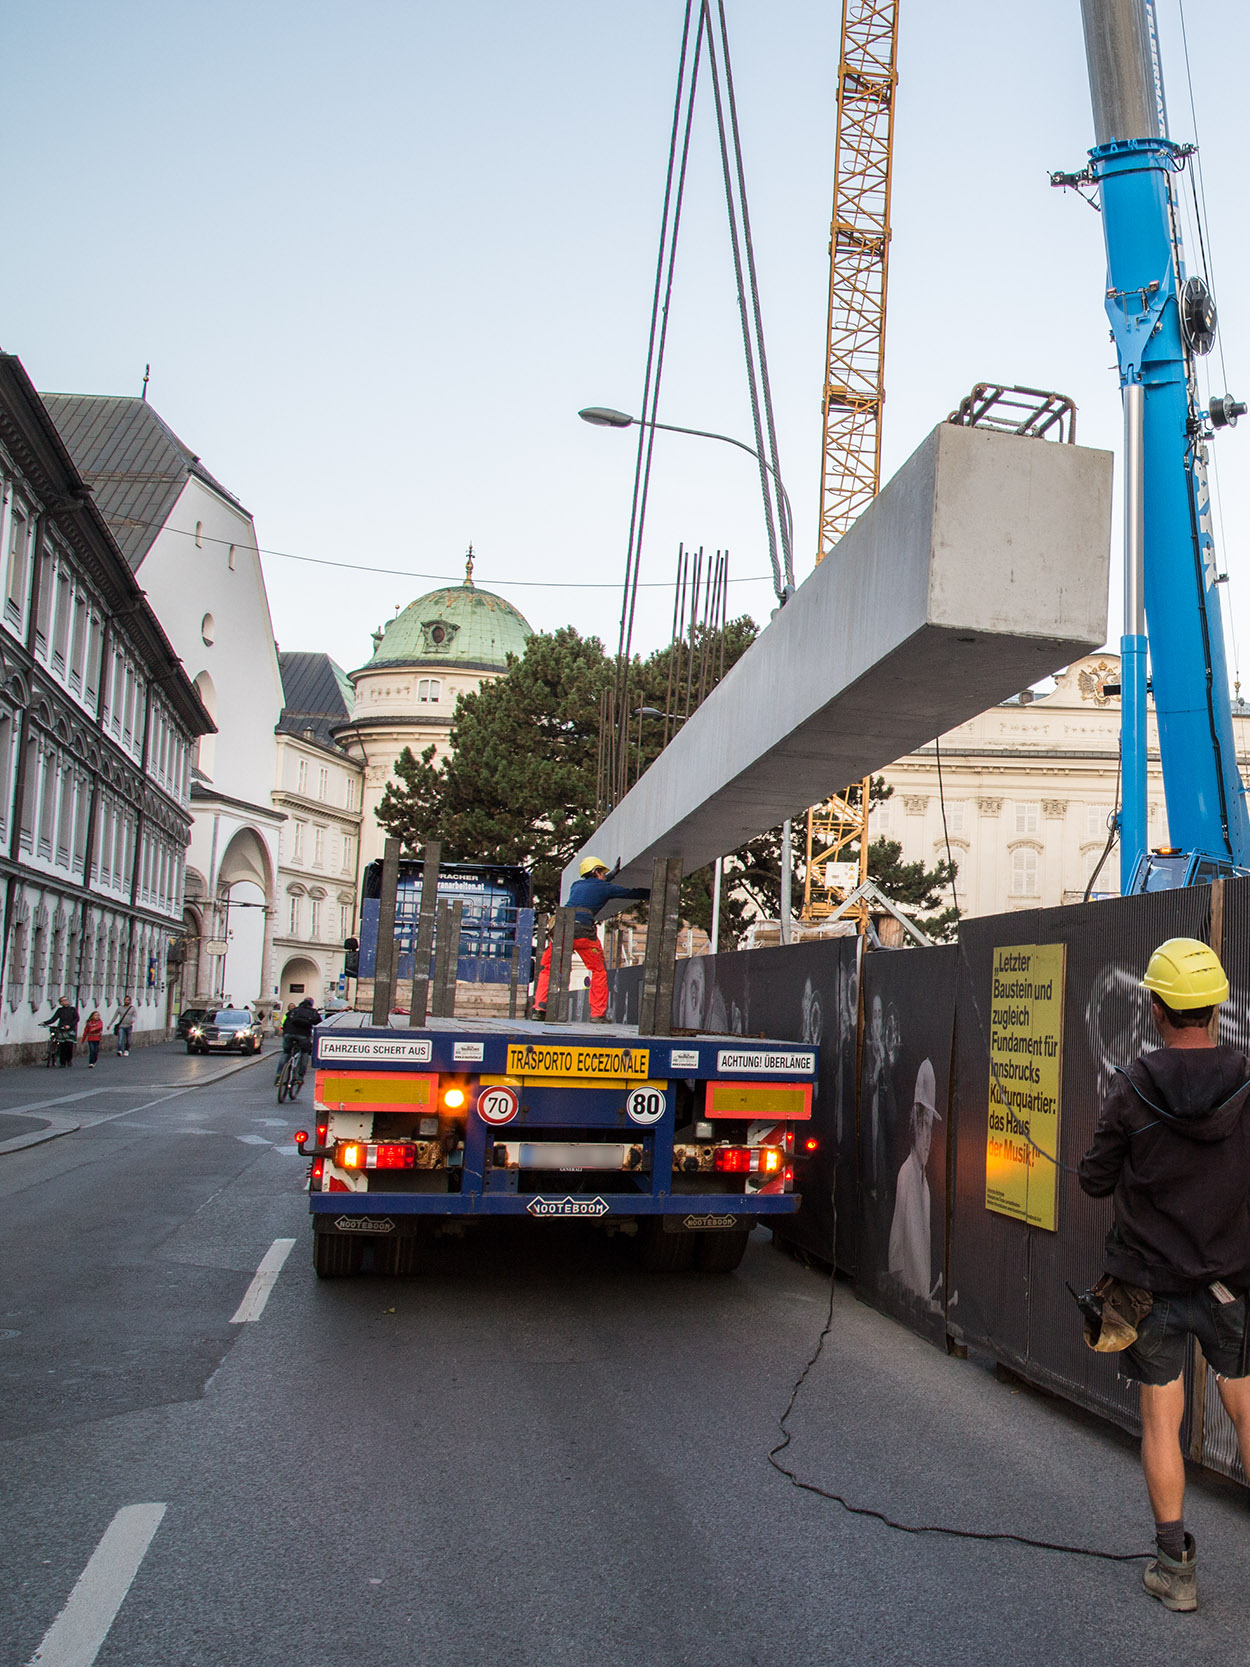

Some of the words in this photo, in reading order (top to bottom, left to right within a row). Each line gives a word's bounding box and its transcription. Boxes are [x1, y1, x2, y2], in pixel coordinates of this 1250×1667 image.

[994, 952, 1031, 976] „Letzter
[993, 978, 1033, 999] Baustein
[1034, 978, 1053, 1000] und
[992, 1004, 1030, 1030] zugleich
[324, 1044, 371, 1054] FAHRZEUG
[372, 1045, 406, 1055] SCHERT
[408, 1046, 426, 1056] AUS
[991, 1031, 1042, 1056] Fundament
[1044, 1035, 1058, 1058] für
[511, 1050, 573, 1071] TRASPORTO
[577, 1052, 647, 1074] ECCEZIONALE
[721, 1055, 762, 1068] ACHTUNG!
[764, 1053, 811, 1069] ÜBERLÄNGE
[990, 1057, 1040, 1084] Innsbrucks
[488, 1097, 508, 1114] 70
[633, 1094, 660, 1115] 80
[990, 1083, 1056, 1115] Kulturquartier:
[989, 1110, 1004, 1131] das
[1006, 1112, 1030, 1136] Haus
[988, 1136, 1003, 1157] der
[533, 1204, 604, 1213] NOOTEBOOM
[340, 1220, 390, 1230] NOOTEBOOM
[687, 1218, 733, 1226] NOOTEBOOM
